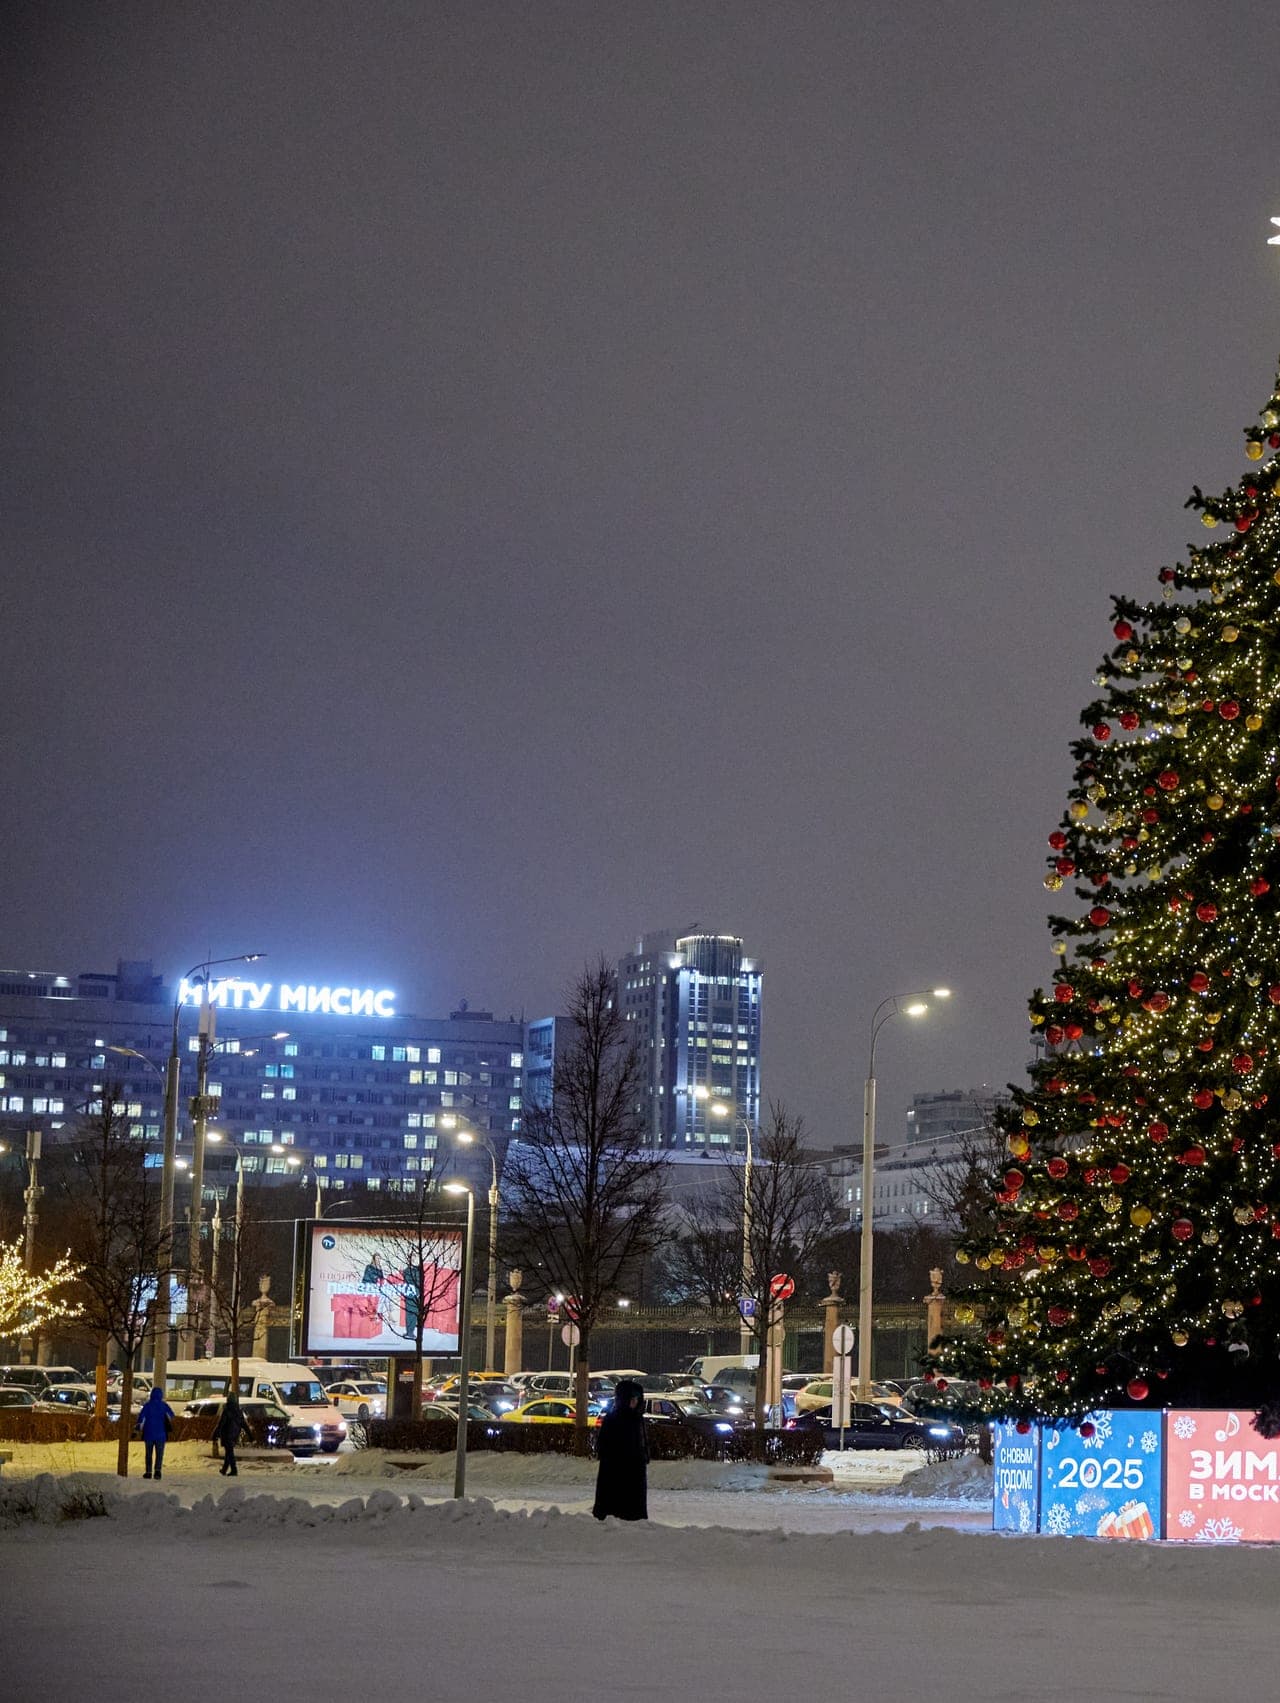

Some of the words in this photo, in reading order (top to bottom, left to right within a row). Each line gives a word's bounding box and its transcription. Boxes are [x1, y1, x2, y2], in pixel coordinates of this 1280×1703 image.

[179, 981, 272, 1009] НИТУ
[279, 984, 396, 1017] МИСИС
[1001, 1448, 1007, 1464] С
[1007, 1448, 1032, 1464] НОВЫМ
[1001, 1470, 1032, 1491] ГОДОМ!
[1058, 1458, 1144, 1490] 2025
[1189, 1484, 1204, 1500] В
